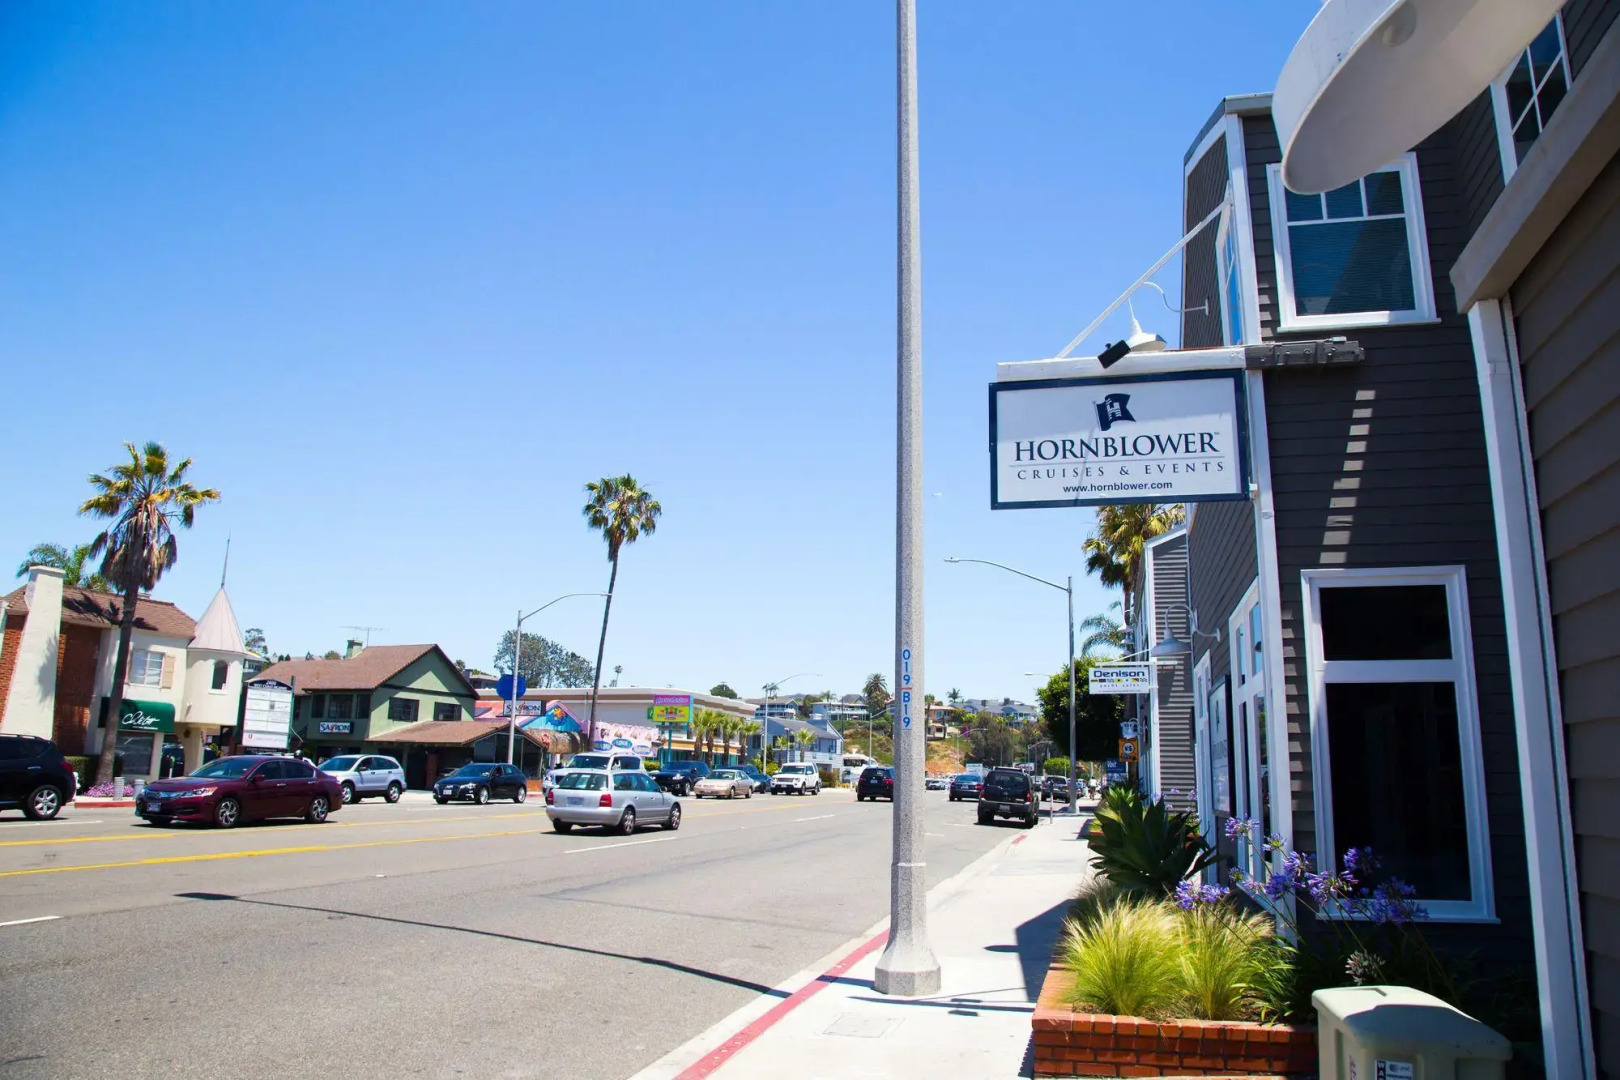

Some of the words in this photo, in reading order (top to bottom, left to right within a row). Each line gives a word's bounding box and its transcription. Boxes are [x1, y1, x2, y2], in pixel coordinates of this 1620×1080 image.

[1014, 432, 1220, 462] HORNBLOWER
[1017, 466, 1105, 480] CRUISES
[1119, 465, 1130, 476] &
[1144, 461, 1224, 475] EVENTS
[1062, 481, 1173, 493] www.hornblower.com
[1093, 670, 1145, 678] Denison
